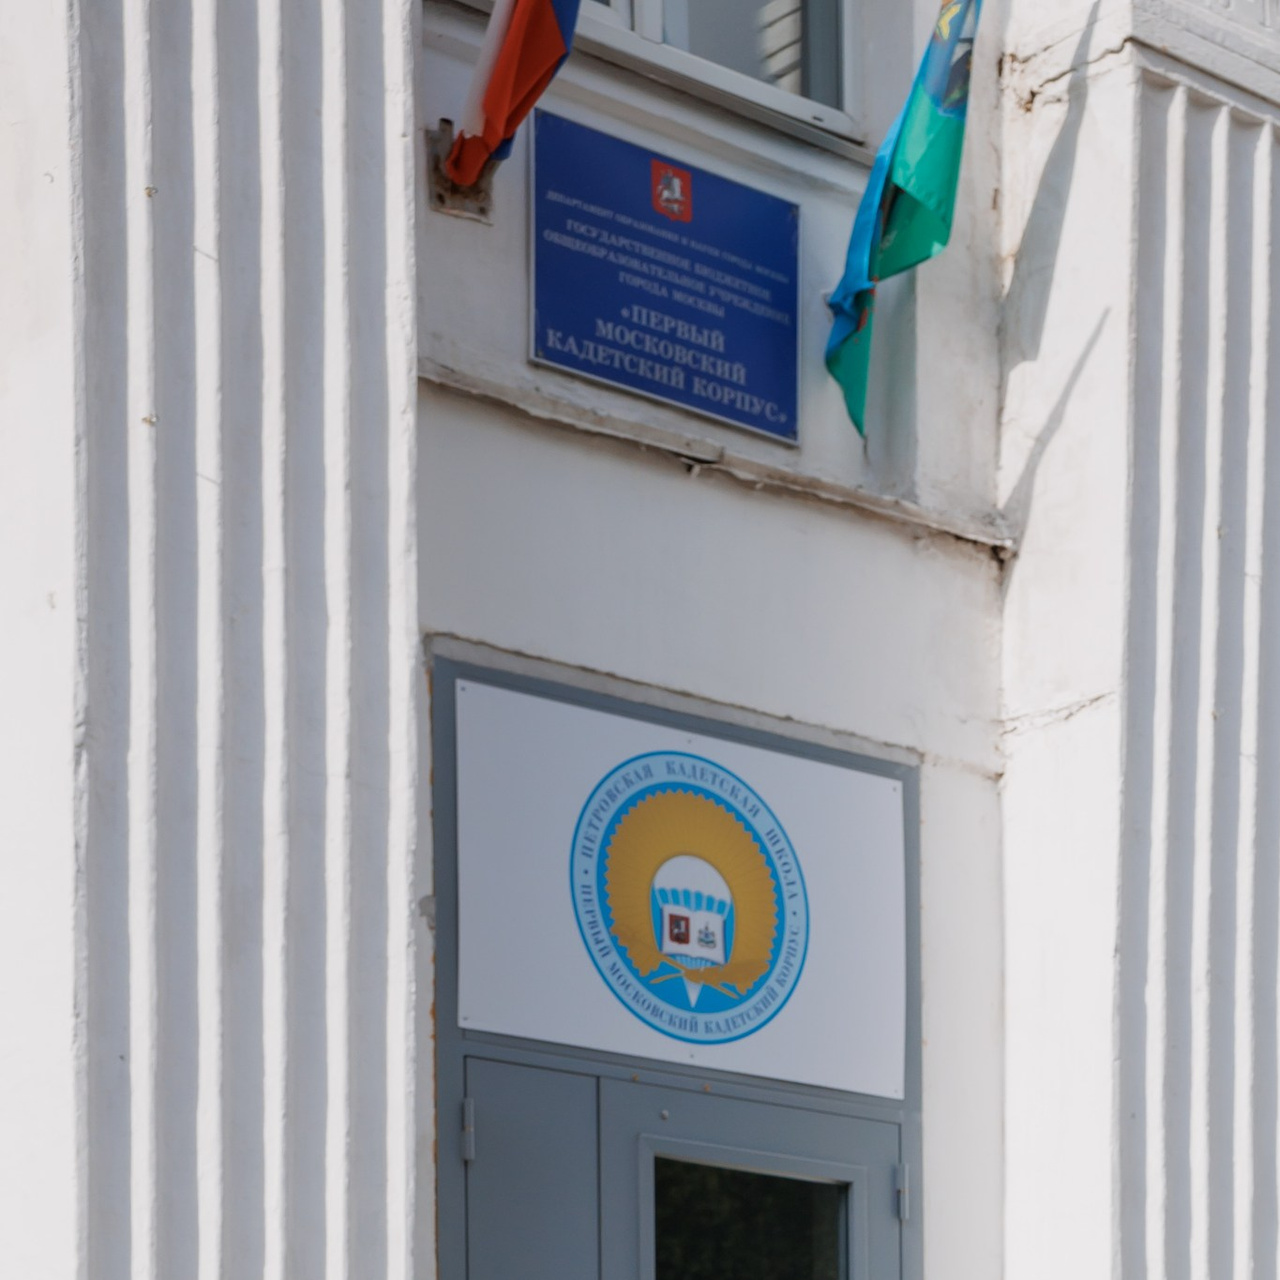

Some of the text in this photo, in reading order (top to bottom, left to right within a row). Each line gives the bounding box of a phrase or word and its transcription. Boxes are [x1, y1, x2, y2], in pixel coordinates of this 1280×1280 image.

[566, 219, 692, 272] ГОСУДАРСТВЕННОЕ
[619, 271, 726, 319] ГОРОДА МОСКВЫ
[621, 304, 725, 353] «ПЕРВЫЙ
[546, 328, 788, 424] КАДЕТСКИЙ КОРПУС»
[596, 318, 747, 387] МОСКОВСКИЙ
[581, 760, 799, 901] ПЕТРОВСКАЯ КАДЕТСКАЯ ШКОЛА
[580, 883, 800, 1035] ПЕРВЫЙ МОСКОВСКИЙ КАДЕТСКИЙ КОРПУС
